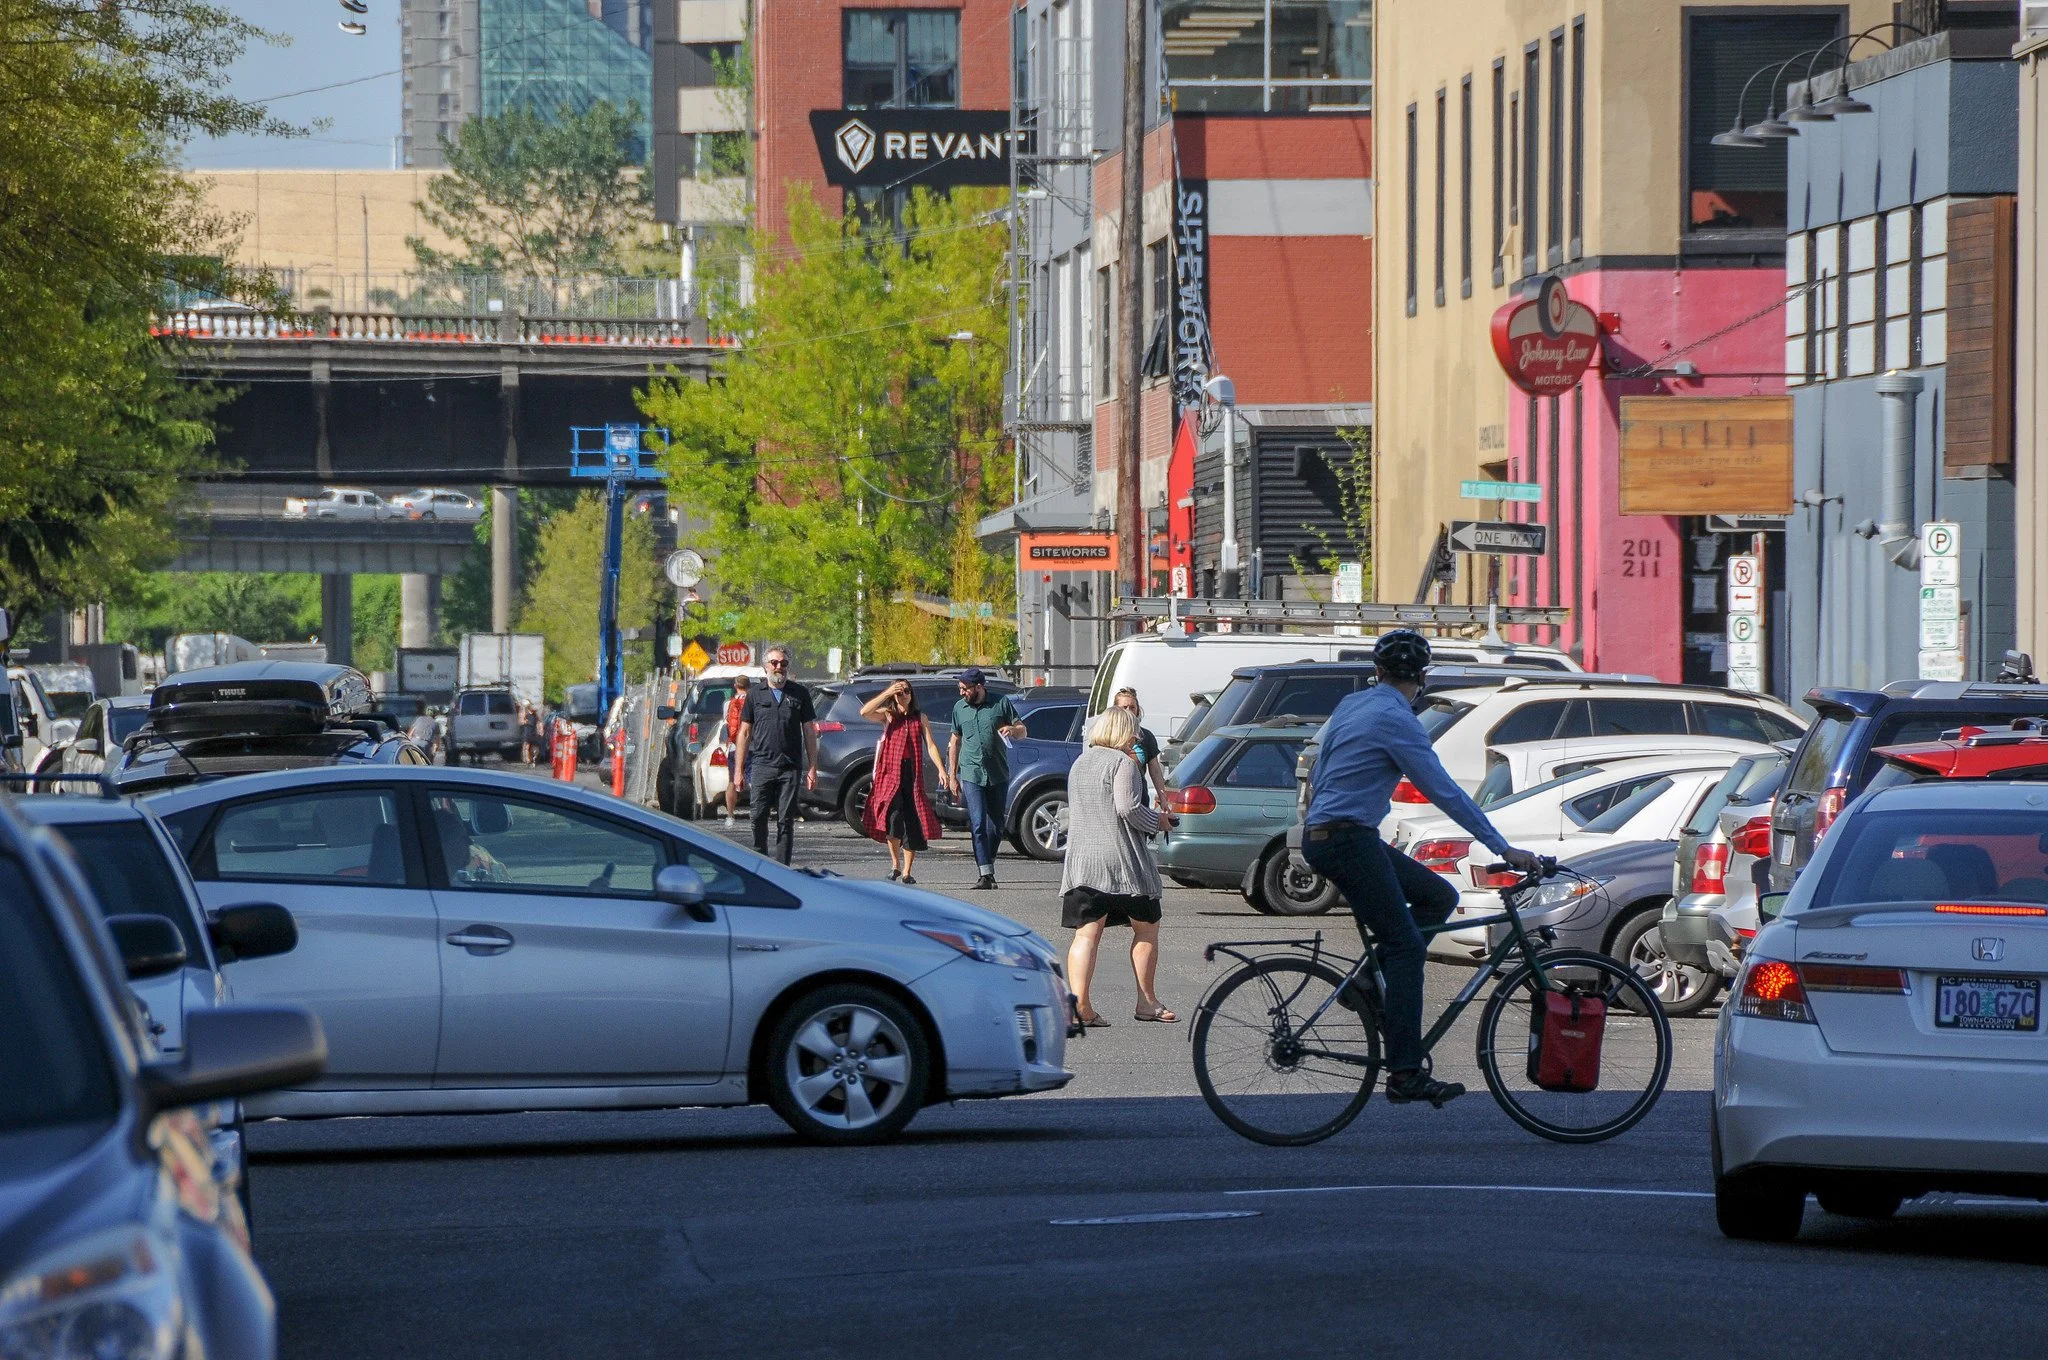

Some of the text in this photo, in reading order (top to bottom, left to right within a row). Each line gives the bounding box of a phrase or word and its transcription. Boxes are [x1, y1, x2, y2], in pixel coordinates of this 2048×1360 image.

[1519, 340, 1564, 370] Johnny
[1534, 375, 1573, 386] MOTORS
[1467, 483, 1480, 495] SE
[1495, 485, 1517, 497] OAK
[1474, 531, 1539, 546] ONE WAY
[1031, 547, 1107, 558] SITEWORKS
[1622, 539, 1663, 558] 201
[1622, 559, 1661, 578] 211
[719, 652, 749, 664] STOP
[218, 688, 246, 696] THULE
[1802, 951, 1868, 960] Accord
[1943, 988, 2034, 1018] 180 GZC
